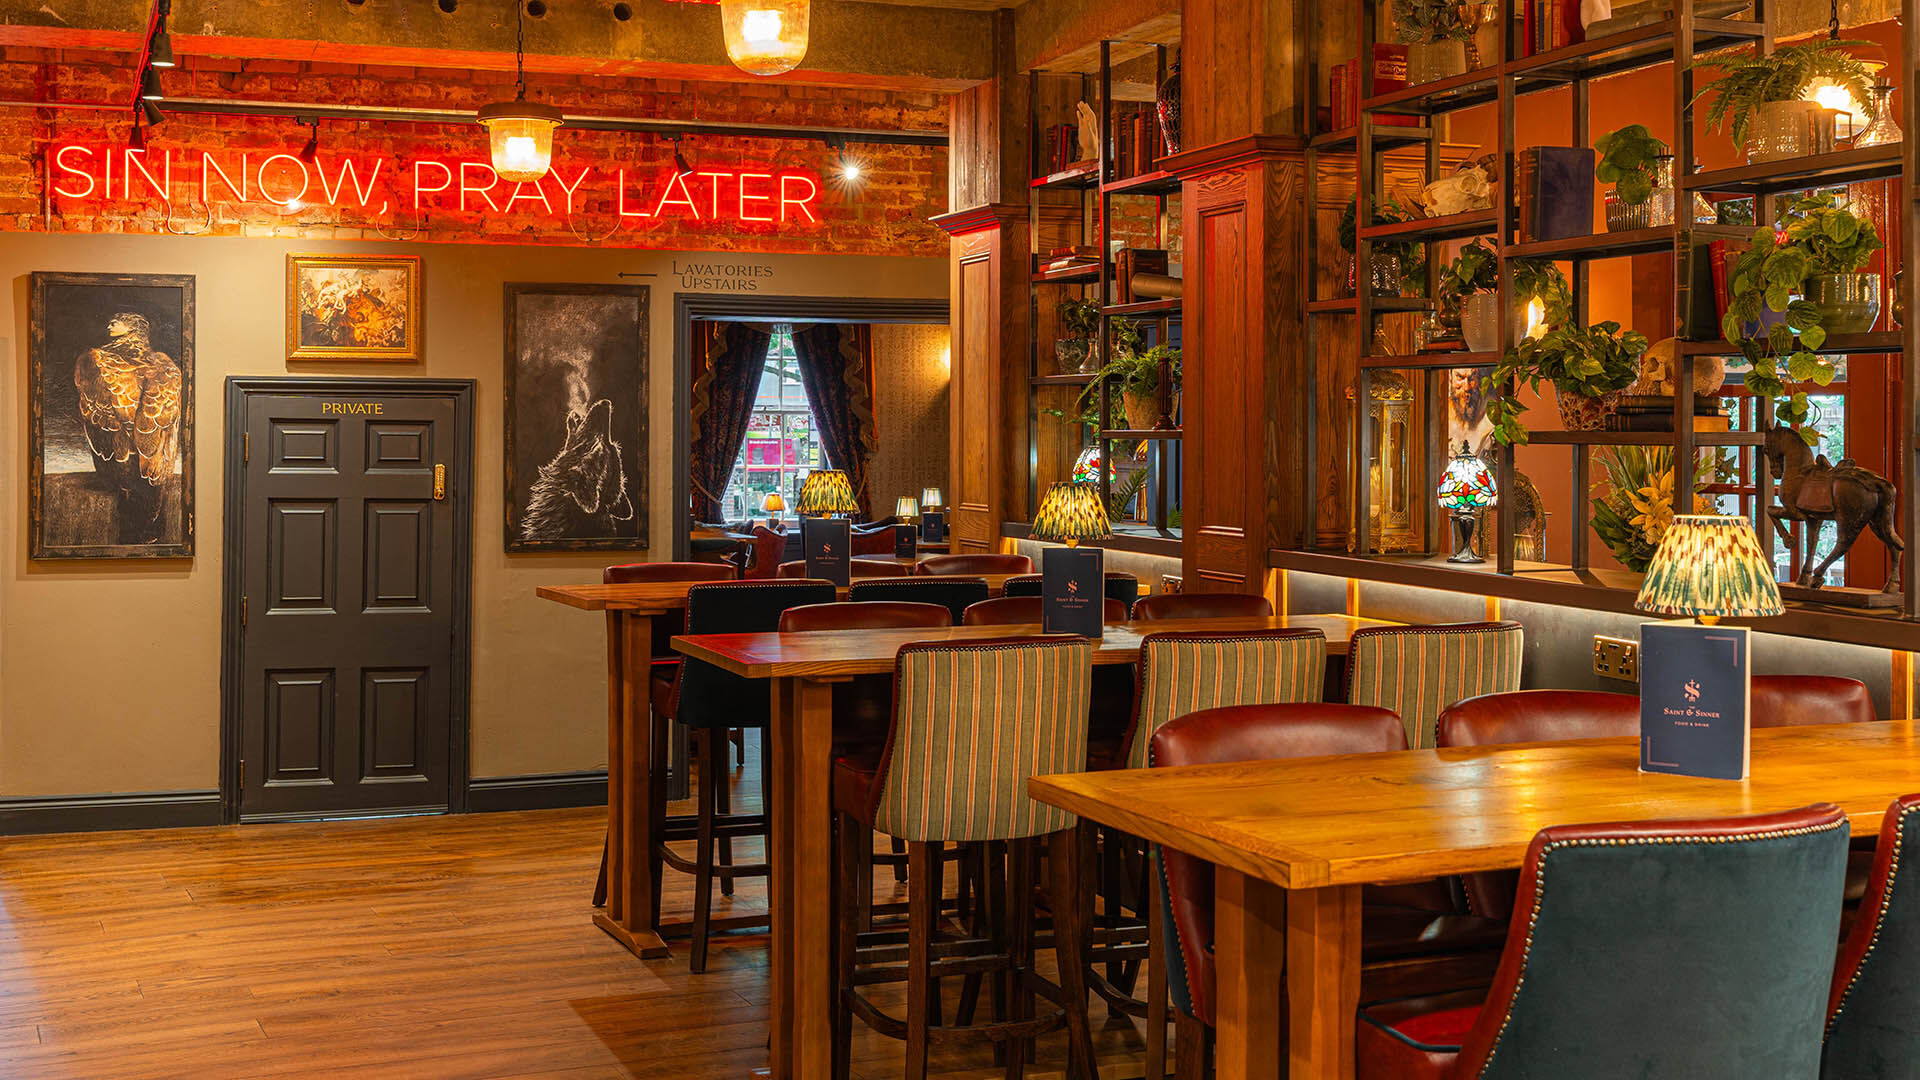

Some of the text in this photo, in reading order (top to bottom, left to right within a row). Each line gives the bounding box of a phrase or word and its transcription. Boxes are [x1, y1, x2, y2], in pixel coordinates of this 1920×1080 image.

[54, 145, 817, 224] SIN NOW, PRAY LATER
[322, 402, 384, 415] PRIVATE
